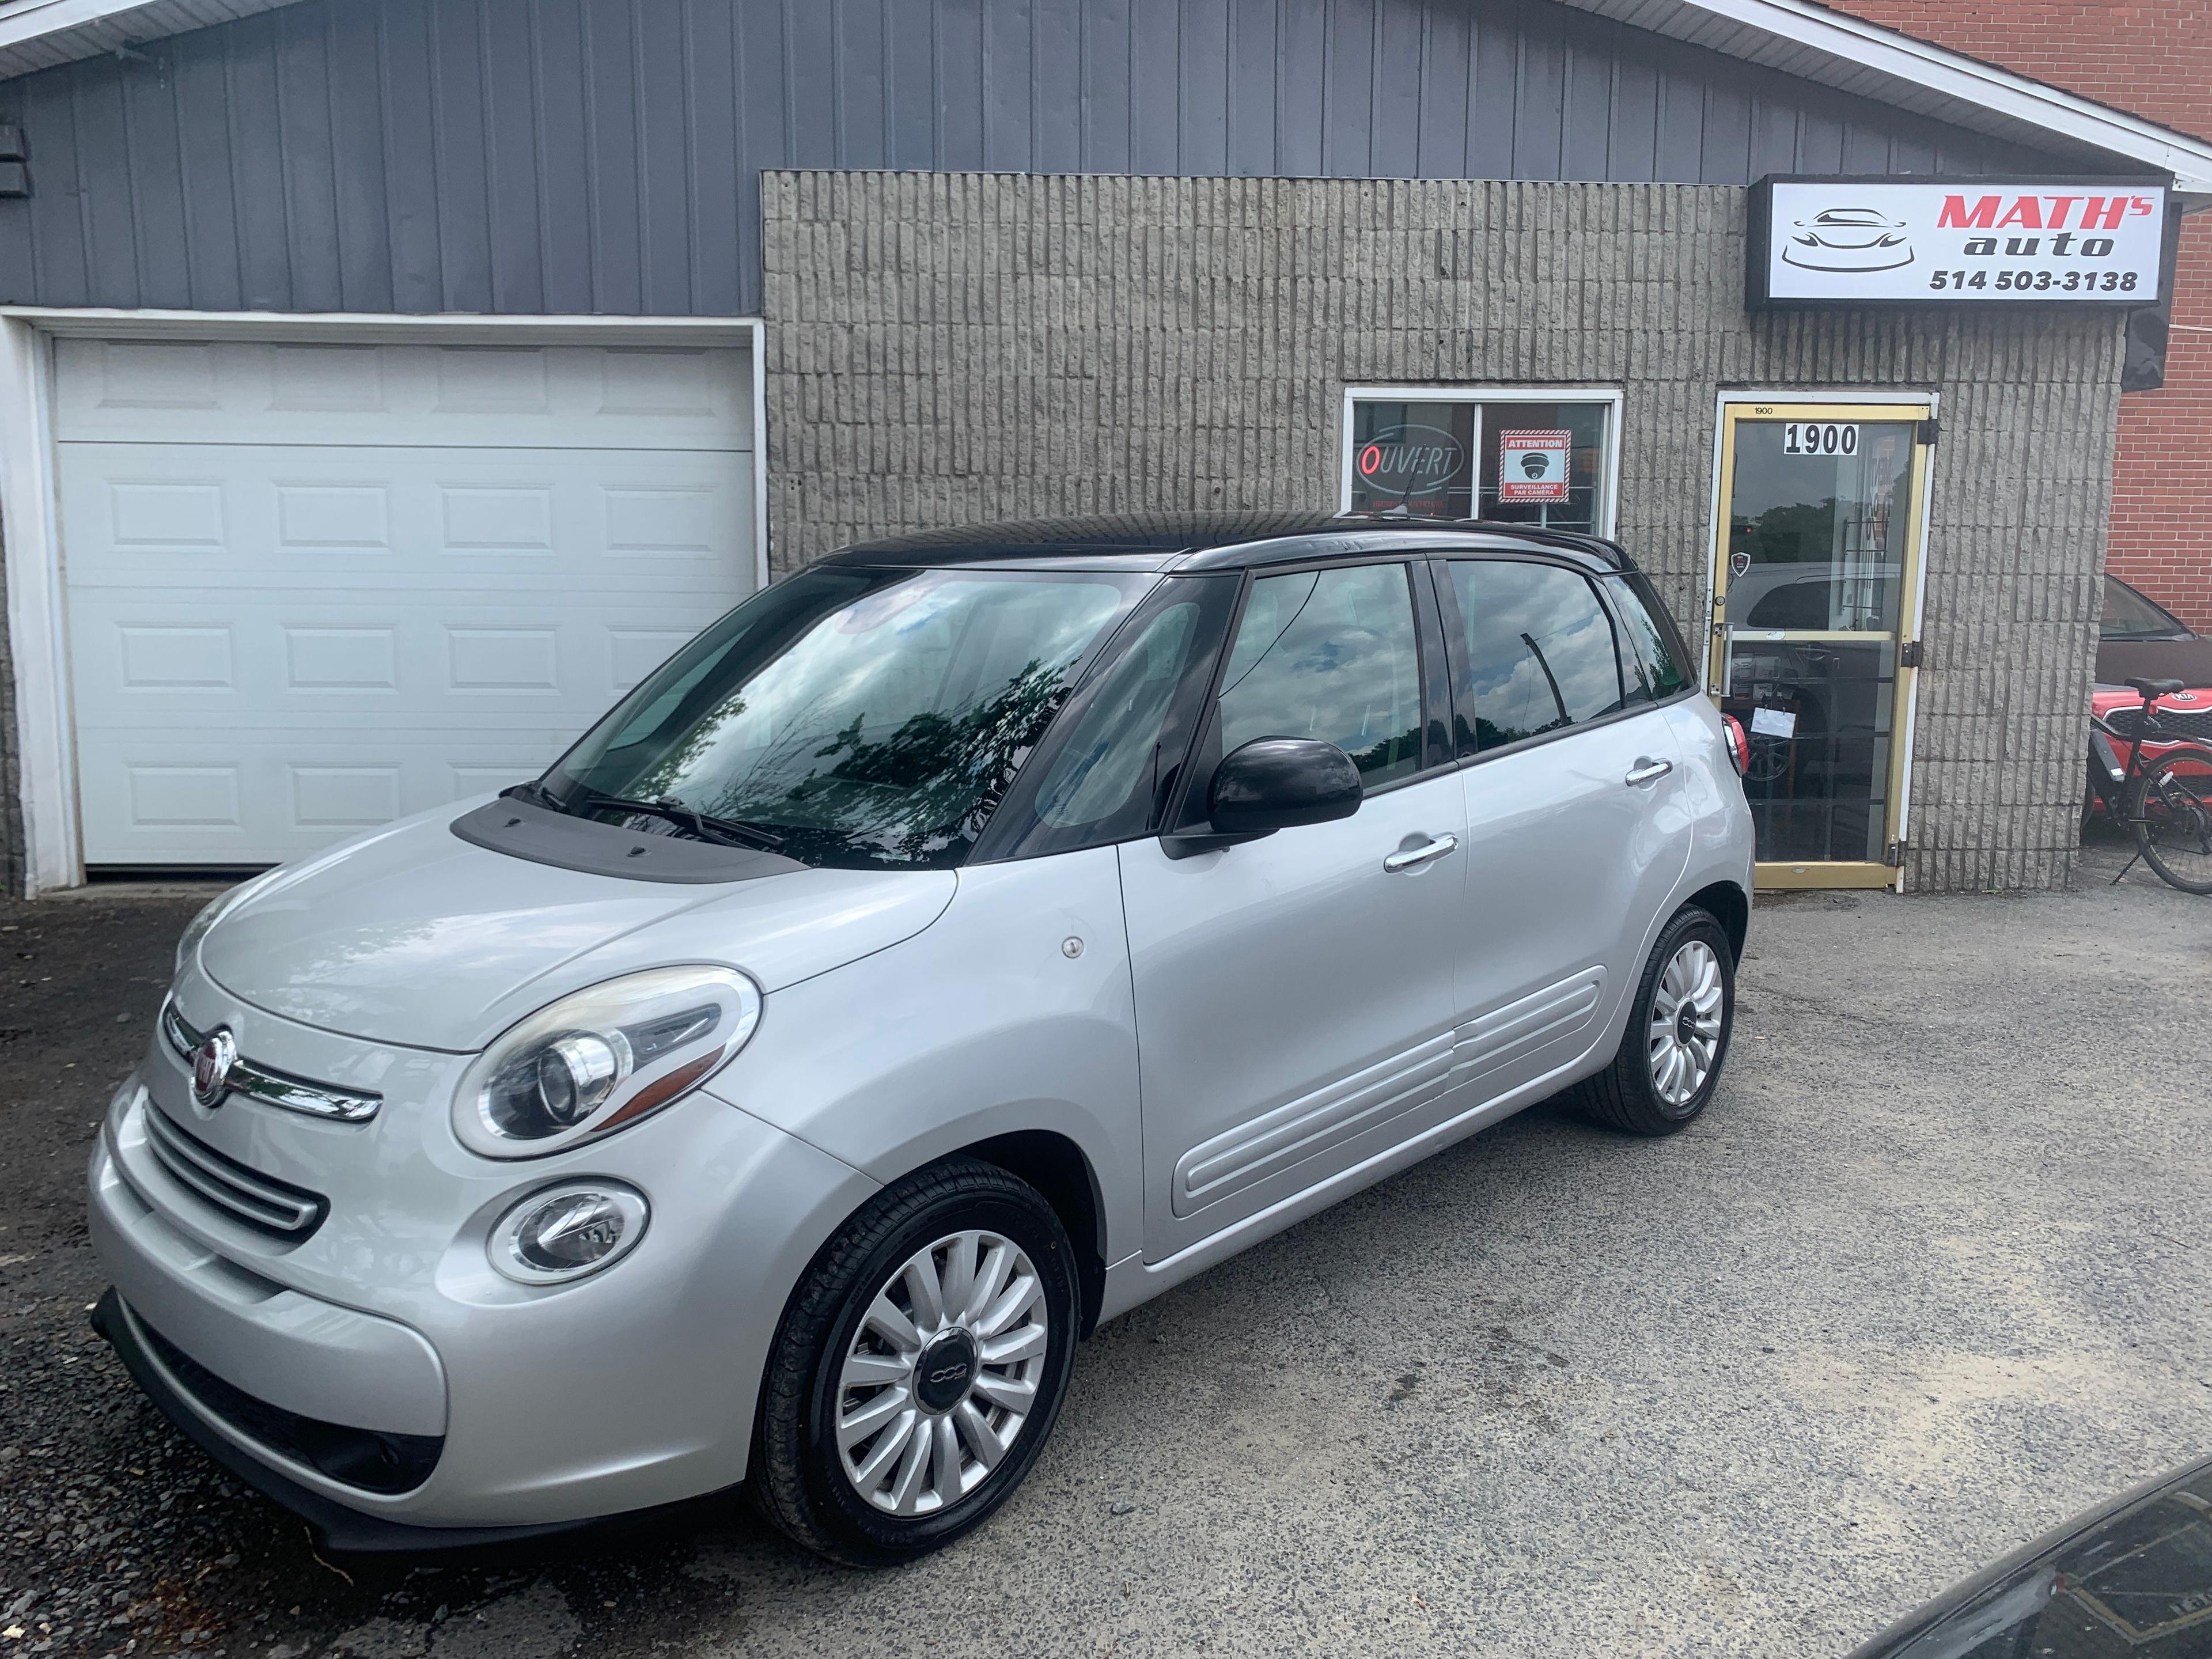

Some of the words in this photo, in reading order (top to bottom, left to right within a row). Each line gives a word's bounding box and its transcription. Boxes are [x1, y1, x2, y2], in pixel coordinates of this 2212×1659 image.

[1963, 232, 2114, 256] auto
[1930, 271, 1987, 290] 514
[1995, 271, 2138, 291] 503-3138
[1508, 440, 1563, 448] ATTENTION
[1786, 425, 1856, 454] 1900
[1362, 446, 1457, 474] OUVERT
